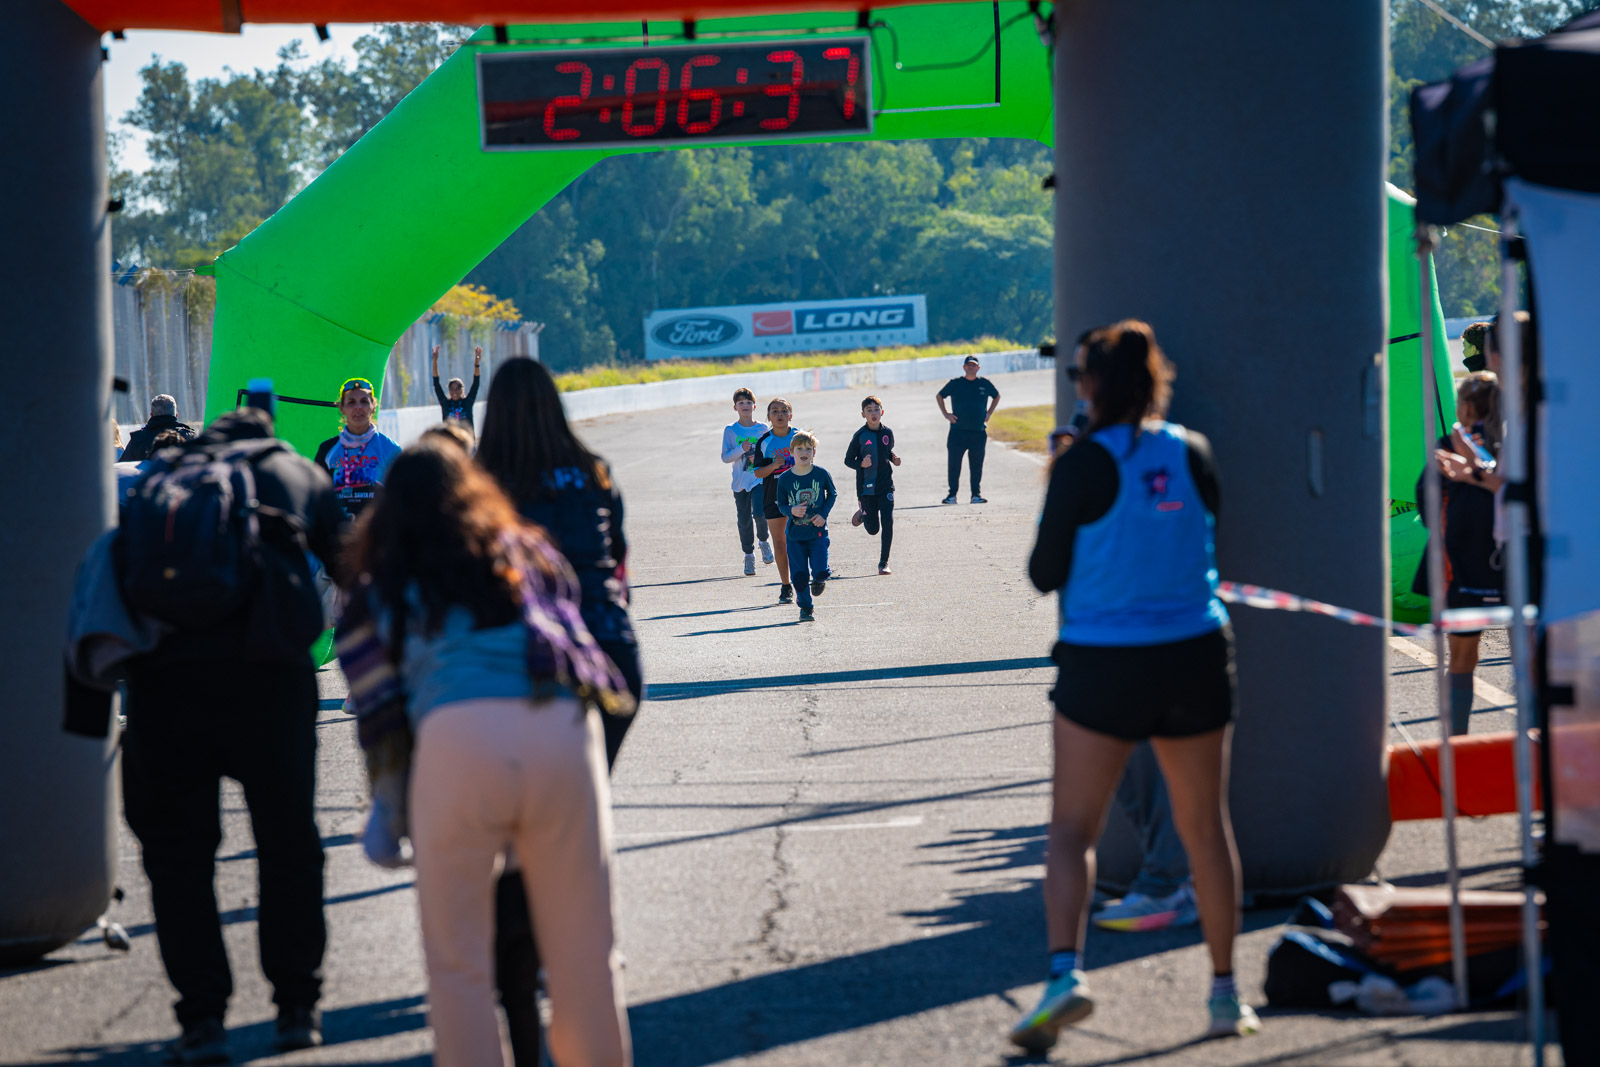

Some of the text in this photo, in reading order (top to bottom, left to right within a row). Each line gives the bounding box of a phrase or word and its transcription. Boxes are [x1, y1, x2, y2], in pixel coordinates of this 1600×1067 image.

[543, 46, 860, 141] 2:06:37
[669, 319, 725, 344] Ford
[803, 309, 906, 330] LONG
